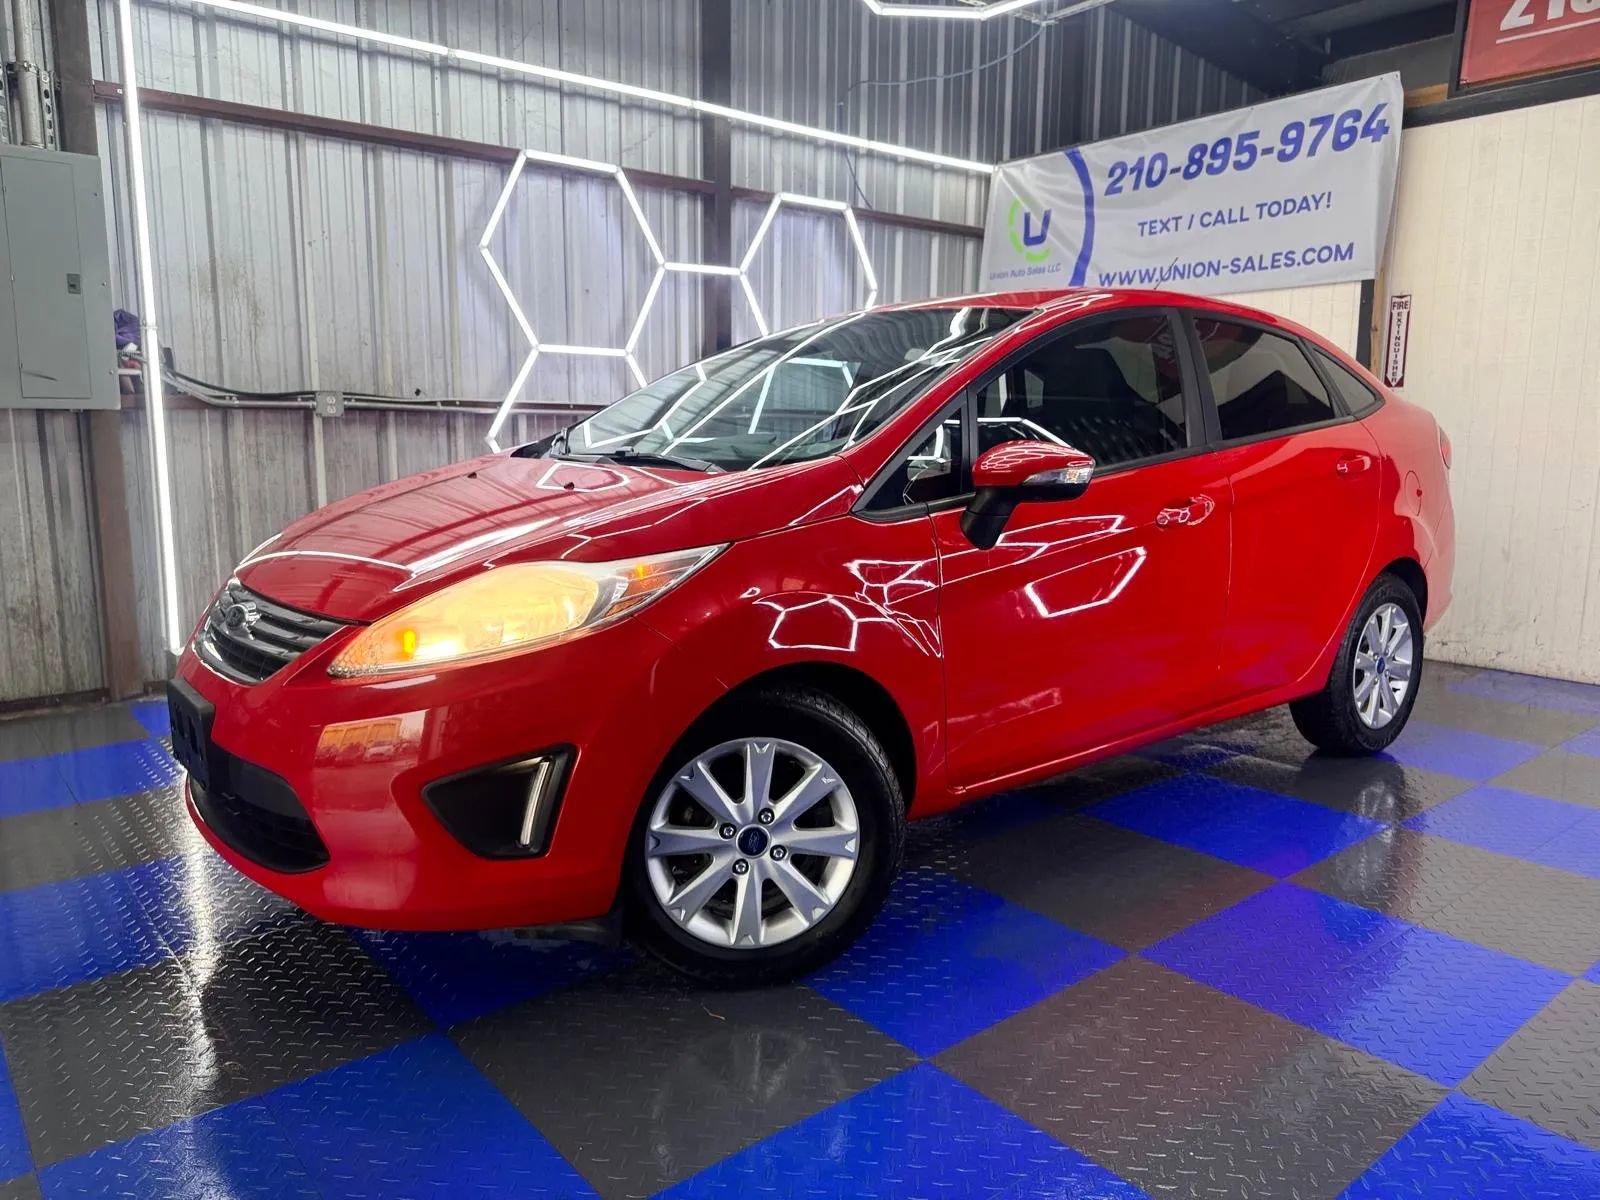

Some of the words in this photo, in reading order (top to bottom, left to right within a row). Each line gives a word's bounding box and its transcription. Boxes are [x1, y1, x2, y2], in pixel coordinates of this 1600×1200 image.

[1104, 103, 1390, 196] 210-895-9764
[1138, 215, 1184, 237] TEXT
[1187, 214, 1195, 230] /
[1200, 206, 1250, 228] CALL
[1256, 191, 1332, 220] TODAY!
[1010, 269, 1026, 278] Auto
[1027, 265, 1046, 276] Sales
[1047, 262, 1061, 273] LLC
[1098, 242, 1354, 287] WWW.UNION-SALES.COM
[1392, 300, 1409, 310] FIRE
[1391, 312, 1402, 382] EXTINGUISHER
